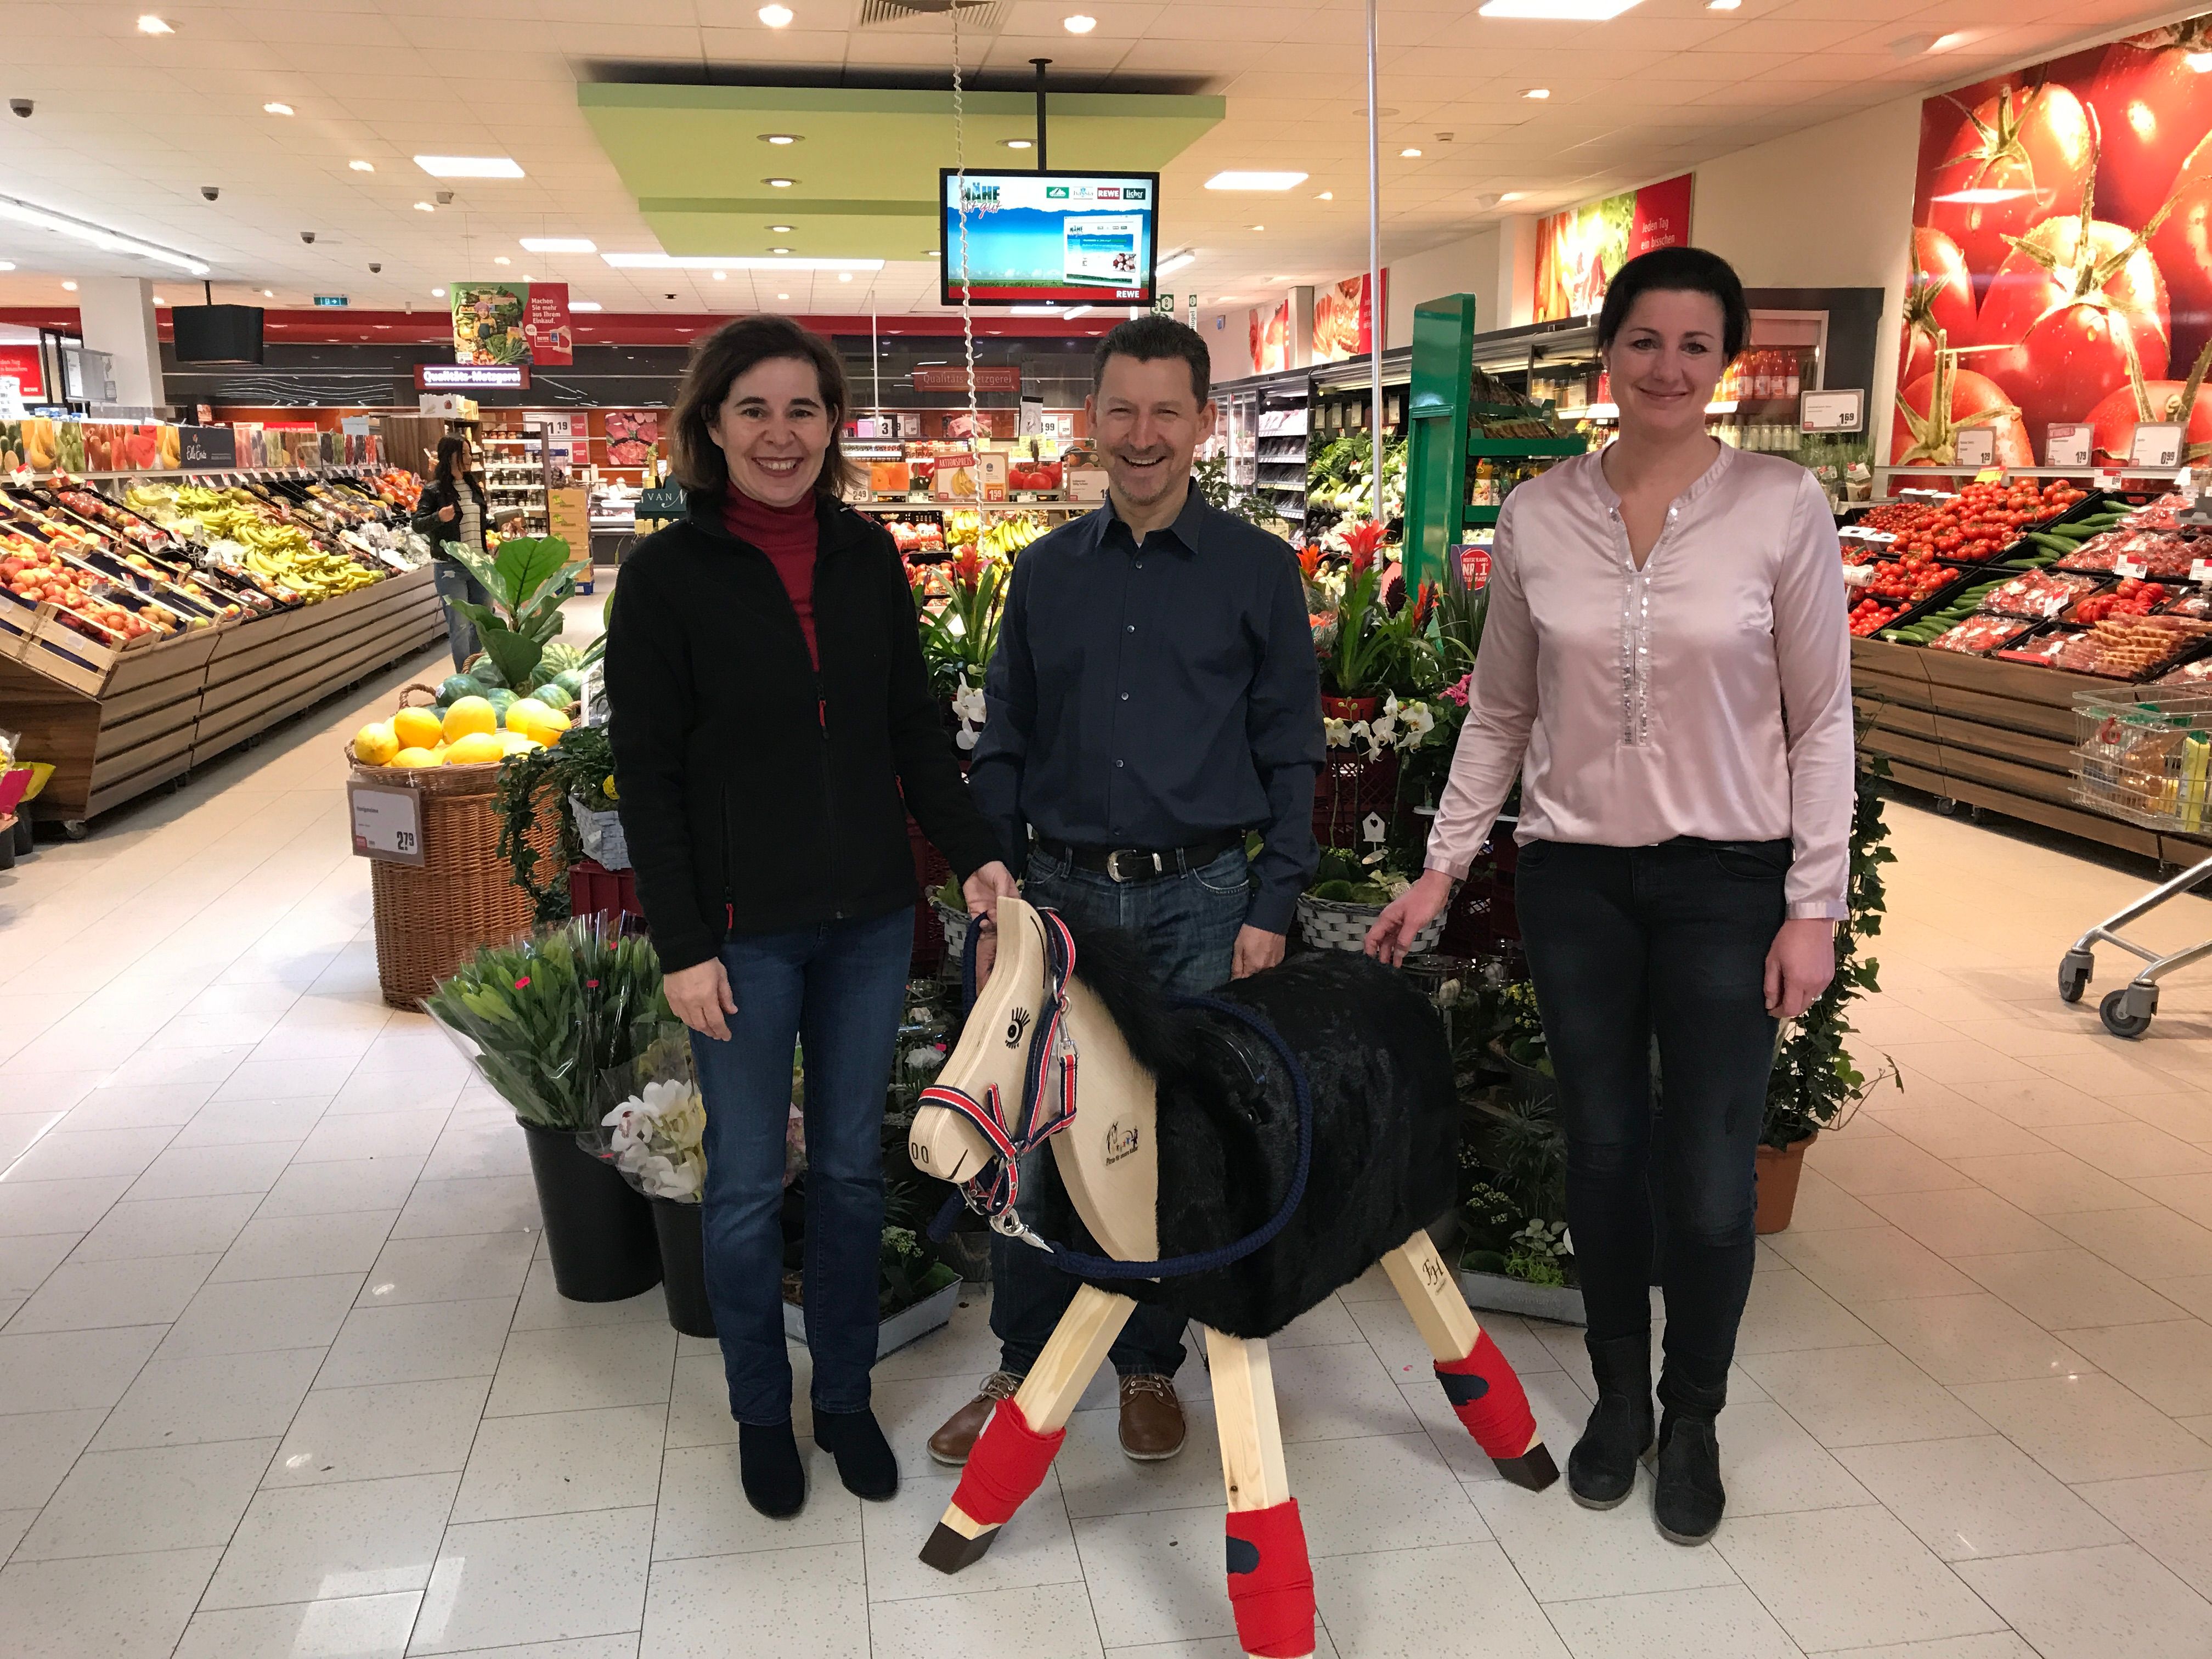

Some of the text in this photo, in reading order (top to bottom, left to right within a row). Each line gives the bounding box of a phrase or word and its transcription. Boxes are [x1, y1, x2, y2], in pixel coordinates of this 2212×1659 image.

[1126, 189, 1144, 198] Licher
[1642, 217, 1669, 233] Jeden Tag
[1641, 234, 1675, 250] ein bisschen
[424, 371, 521, 383] Qualitäts-Metzgerei
[1839, 413, 1854, 424] 1.69
[548, 422, 567, 434] 1.19
[882, 422, 889, 435] 3
[939, 456, 972, 467] AKTIONSPREIS
[1981, 453, 1990, 464] 1.29
[2076, 452, 2086, 463] 1.79
[2161, 452, 2175, 464] 0.99
[853, 490, 866, 500] 2.49
[989, 490, 1002, 500] 1.59
[397, 831, 414, 851] 2.79
